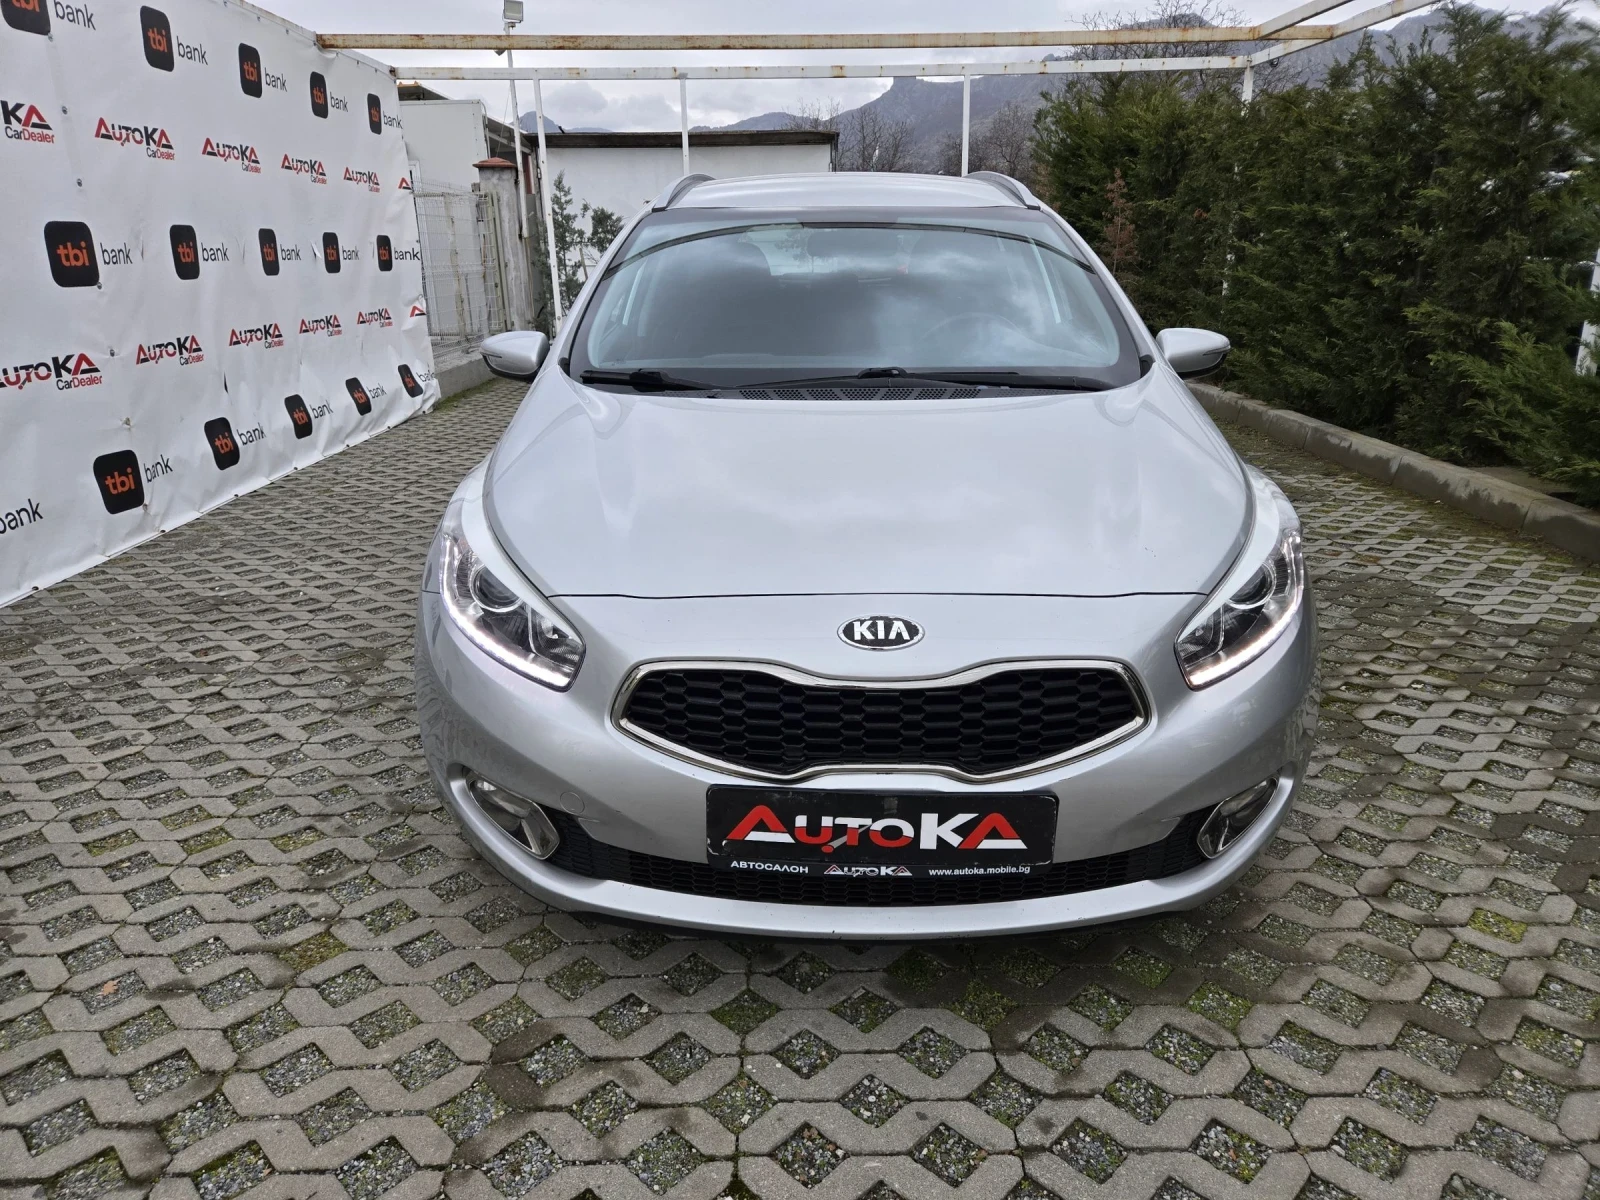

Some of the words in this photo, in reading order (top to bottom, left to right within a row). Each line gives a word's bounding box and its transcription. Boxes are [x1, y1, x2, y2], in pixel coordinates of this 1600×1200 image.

[54, 0, 96, 31] bank
[147, 28, 167, 53] tbi
[177, 36, 208, 66] bank
[243, 61, 258, 83] tbi
[265, 69, 287, 92] bank
[331, 92, 348, 113] bank
[383, 111, 403, 129] bank
[5, 126, 55, 144] CarDealer
[146, 146, 176, 161] CarDealer
[57, 242, 89, 267] tbi
[100, 242, 133, 266] bank
[177, 243, 194, 263] tbi
[201, 243, 229, 262] bank
[263, 245, 275, 261] tbi
[281, 243, 301, 261] bank
[342, 246, 359, 261] bank
[394, 247, 420, 261] bank
[179, 353, 205, 366] CarDealer
[56, 375, 103, 391] CarDealer
[369, 382, 387, 399] bank
[293, 407, 309, 424] tbi
[310, 400, 334, 419] bank
[214, 431, 234, 454] tbi
[236, 422, 267, 446] bank
[105, 468, 136, 495] tbi
[143, 454, 173, 483] bank
[852, 620, 911, 641] KIA
[730, 860, 809, 874] АВТОСАЛОН
[929, 864, 1031, 878] www.autoka.mobile.bg
